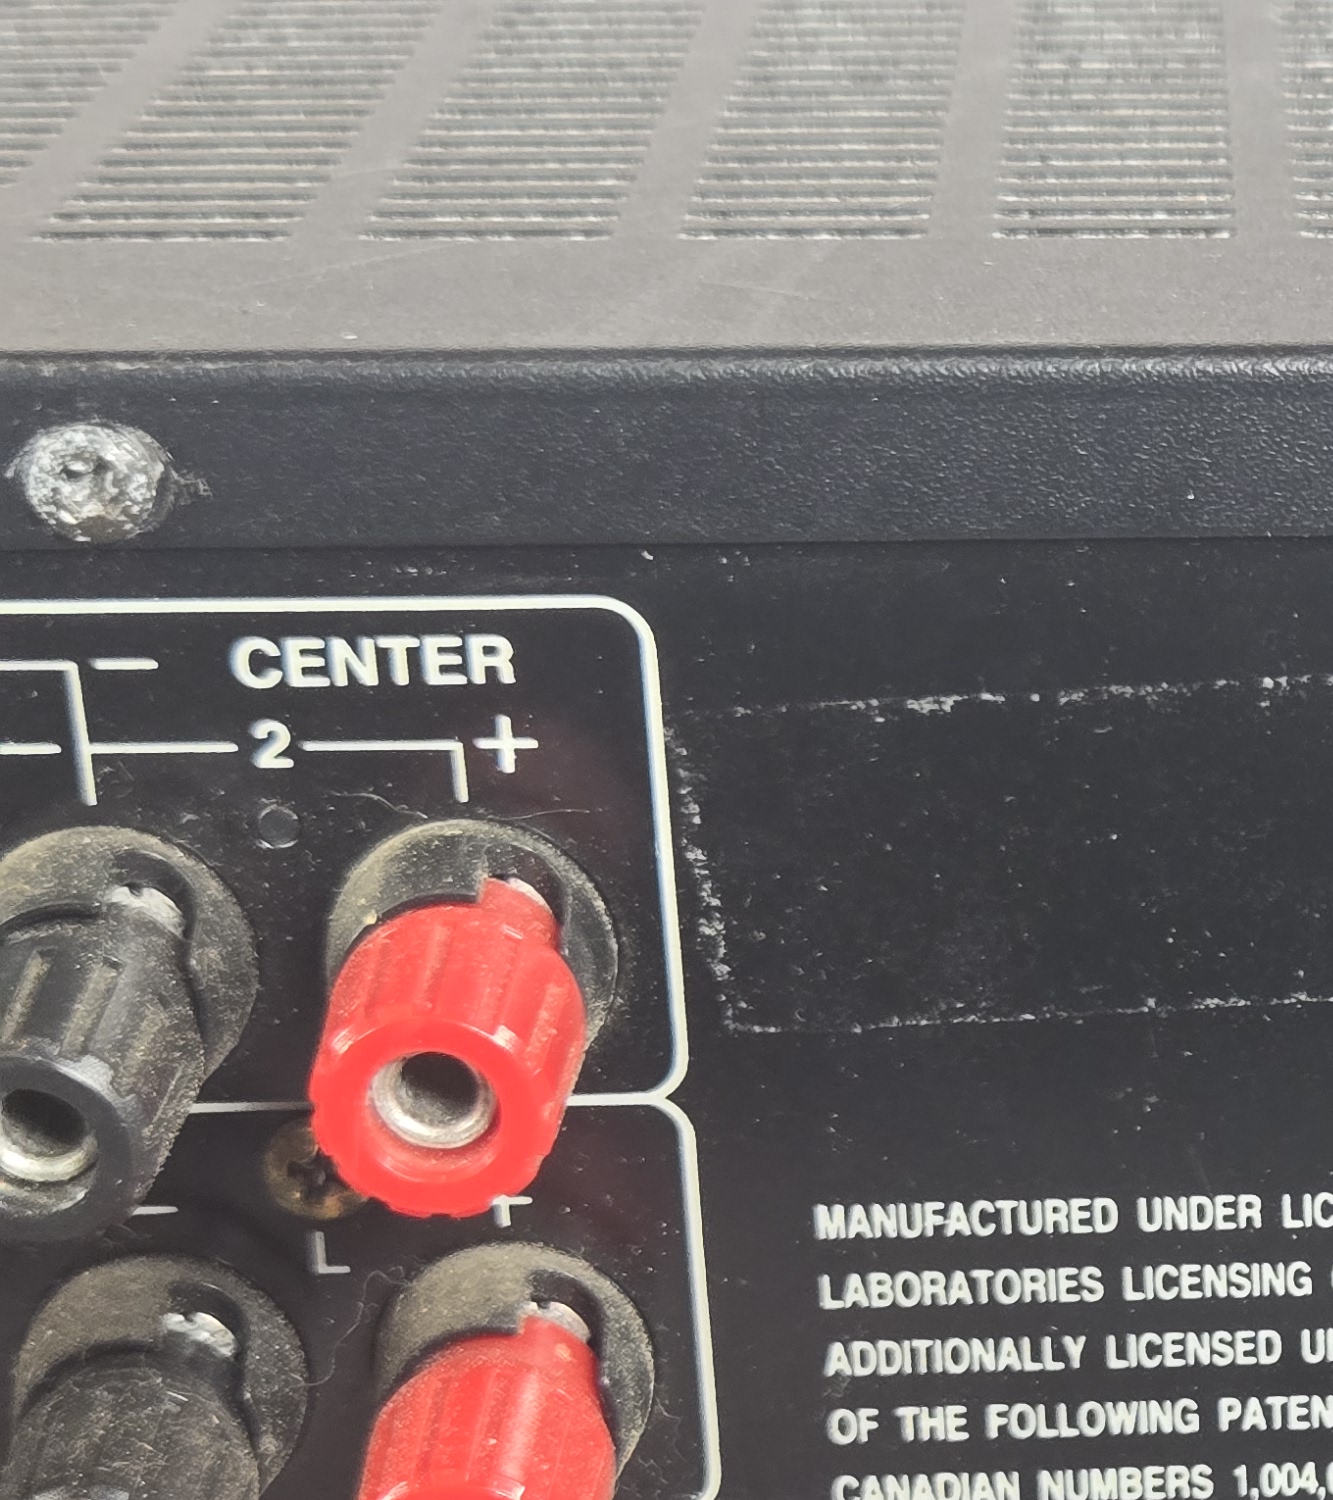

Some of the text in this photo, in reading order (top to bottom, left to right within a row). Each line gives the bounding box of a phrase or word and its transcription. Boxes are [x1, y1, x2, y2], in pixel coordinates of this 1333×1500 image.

[231, 634, 516, 689] CENTER
[251, 719, 294, 768] 2
[814, 1197, 1118, 1239] MANUFACTURED
[1137, 1194, 1262, 1232] UNDER
[819, 1266, 1104, 1309] LABORATORIES
[1122, 1261, 1312, 1301] LICENSING
[824, 1336, 1086, 1376] ADDITIONALLY
[1106, 1330, 1282, 1369] LICENSED
[827, 1408, 879, 1445] OF
[895, 1405, 969, 1442] THE
[986, 1398, 1199, 1439] FOLLOWING
